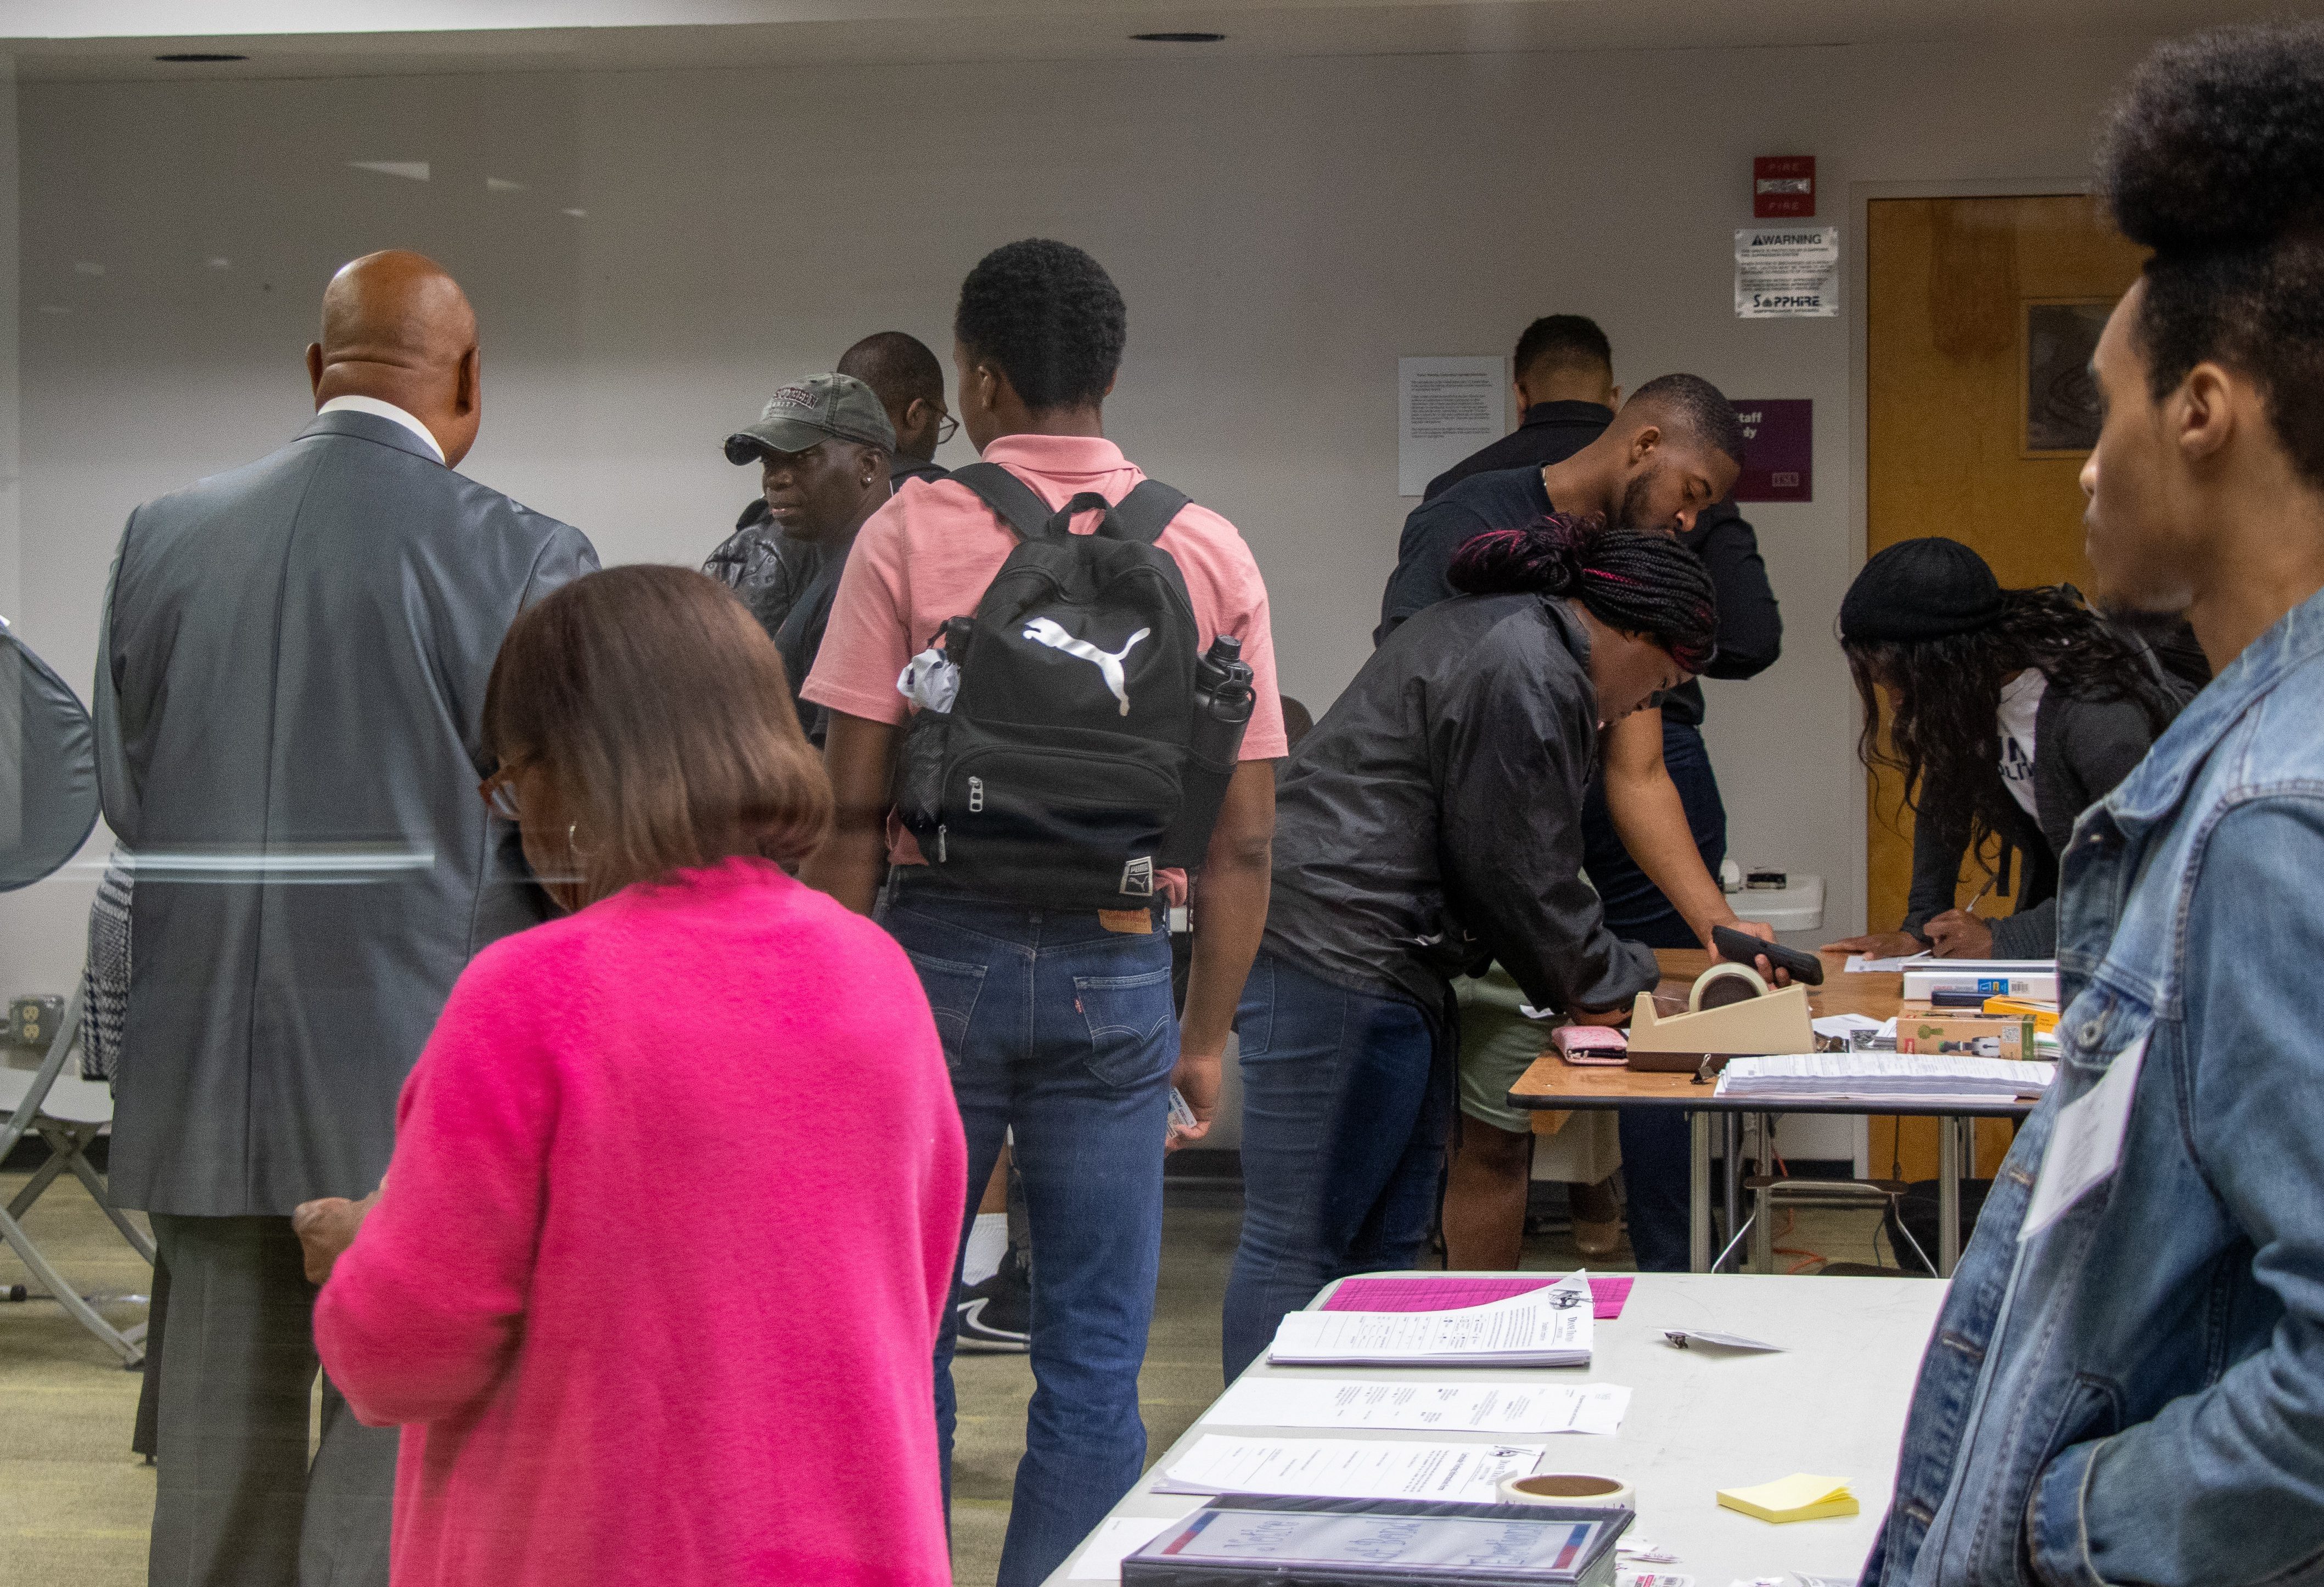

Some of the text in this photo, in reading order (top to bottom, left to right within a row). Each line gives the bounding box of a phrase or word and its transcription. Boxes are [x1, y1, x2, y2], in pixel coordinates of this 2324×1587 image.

[1769, 201, 1800, 210] FIRE
[1762, 234, 1822, 245] WARNING
[1738, 411, 1762, 423] taff
[1742, 427, 1757, 439] dy
[1223, 1521, 1299, 1551] Notice
